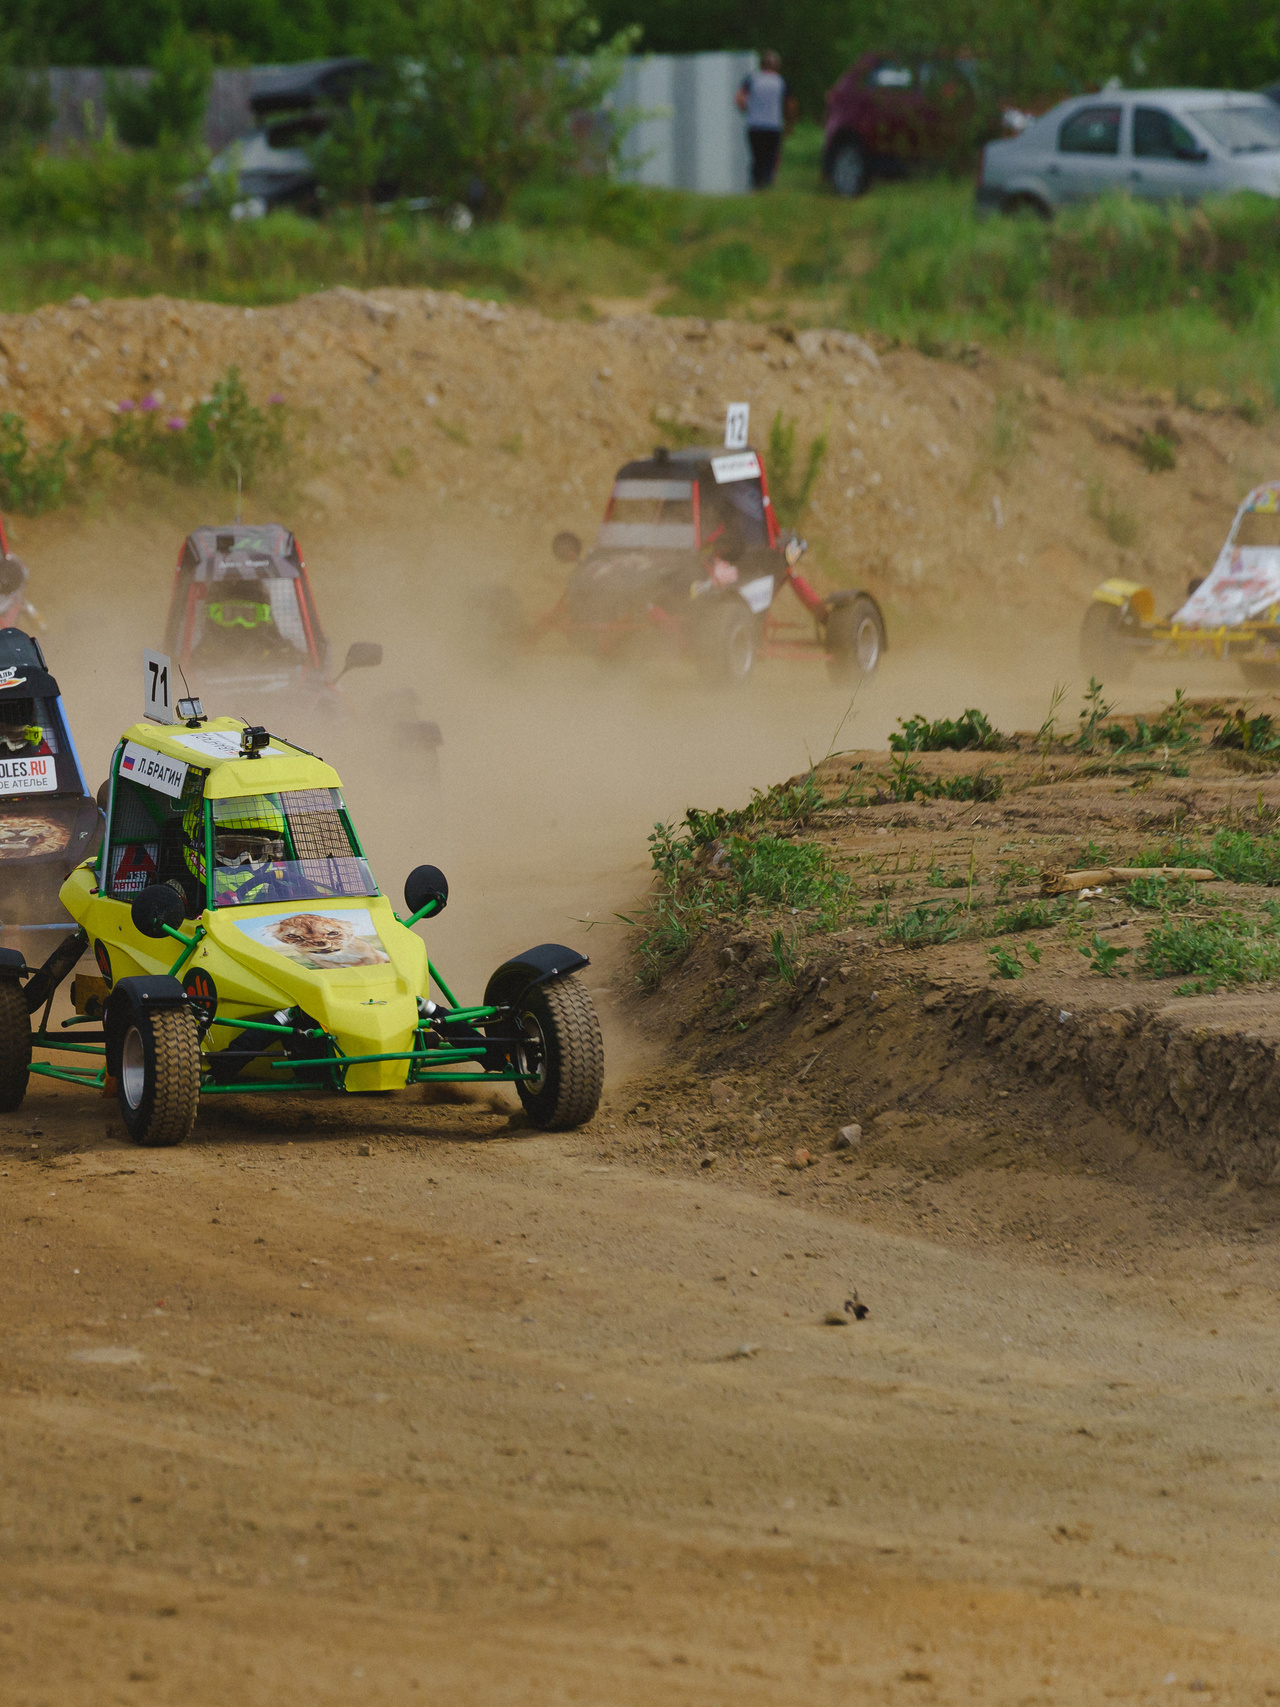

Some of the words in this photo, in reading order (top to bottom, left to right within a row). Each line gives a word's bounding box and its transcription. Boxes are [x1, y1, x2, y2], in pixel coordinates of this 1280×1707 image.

[730, 412, 745, 441] 12
[149, 661, 168, 708] 71
[12, 777, 49, 789] АТЕЛЬЕ
[138, 757, 183, 788] Л.БРАГИН
